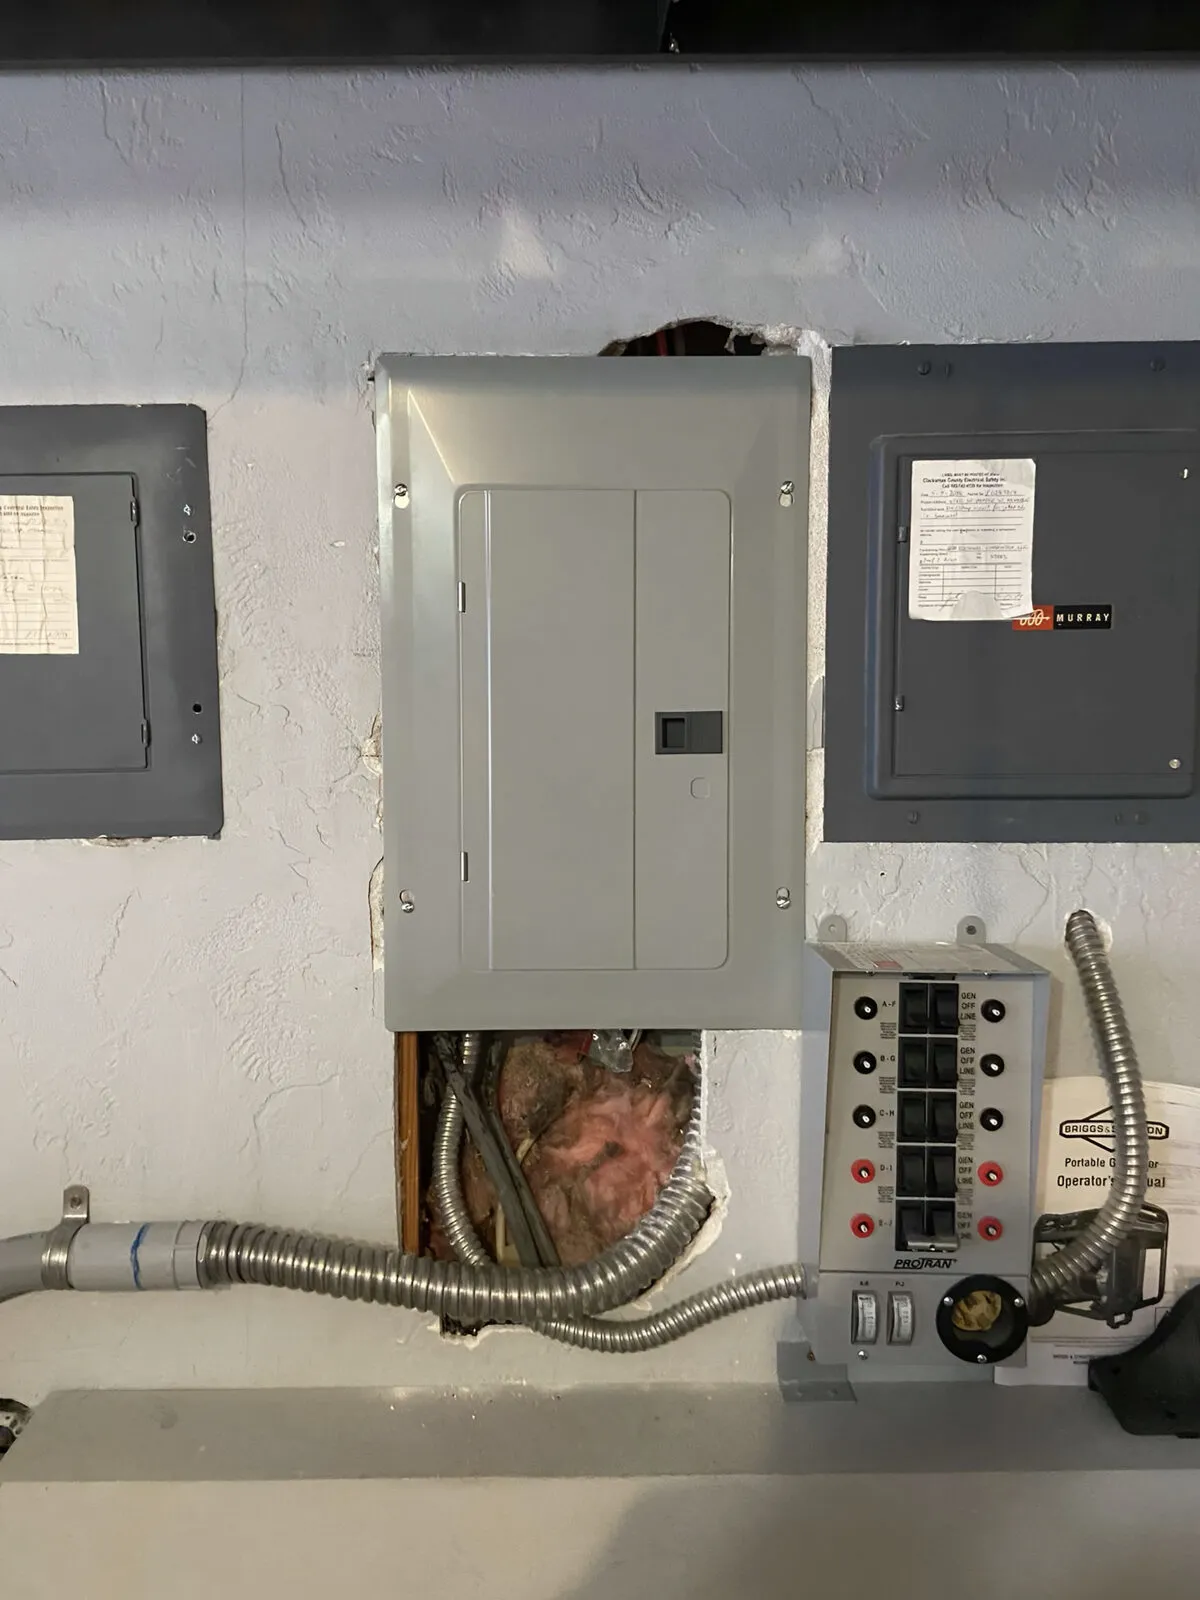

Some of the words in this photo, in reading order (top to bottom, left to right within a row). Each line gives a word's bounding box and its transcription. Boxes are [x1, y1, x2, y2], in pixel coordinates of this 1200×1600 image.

[1056, 613, 1109, 622] MURRAY
[1064, 1124, 1104, 1133] BRIGGS
[1064, 1158, 1106, 1168] Portable
